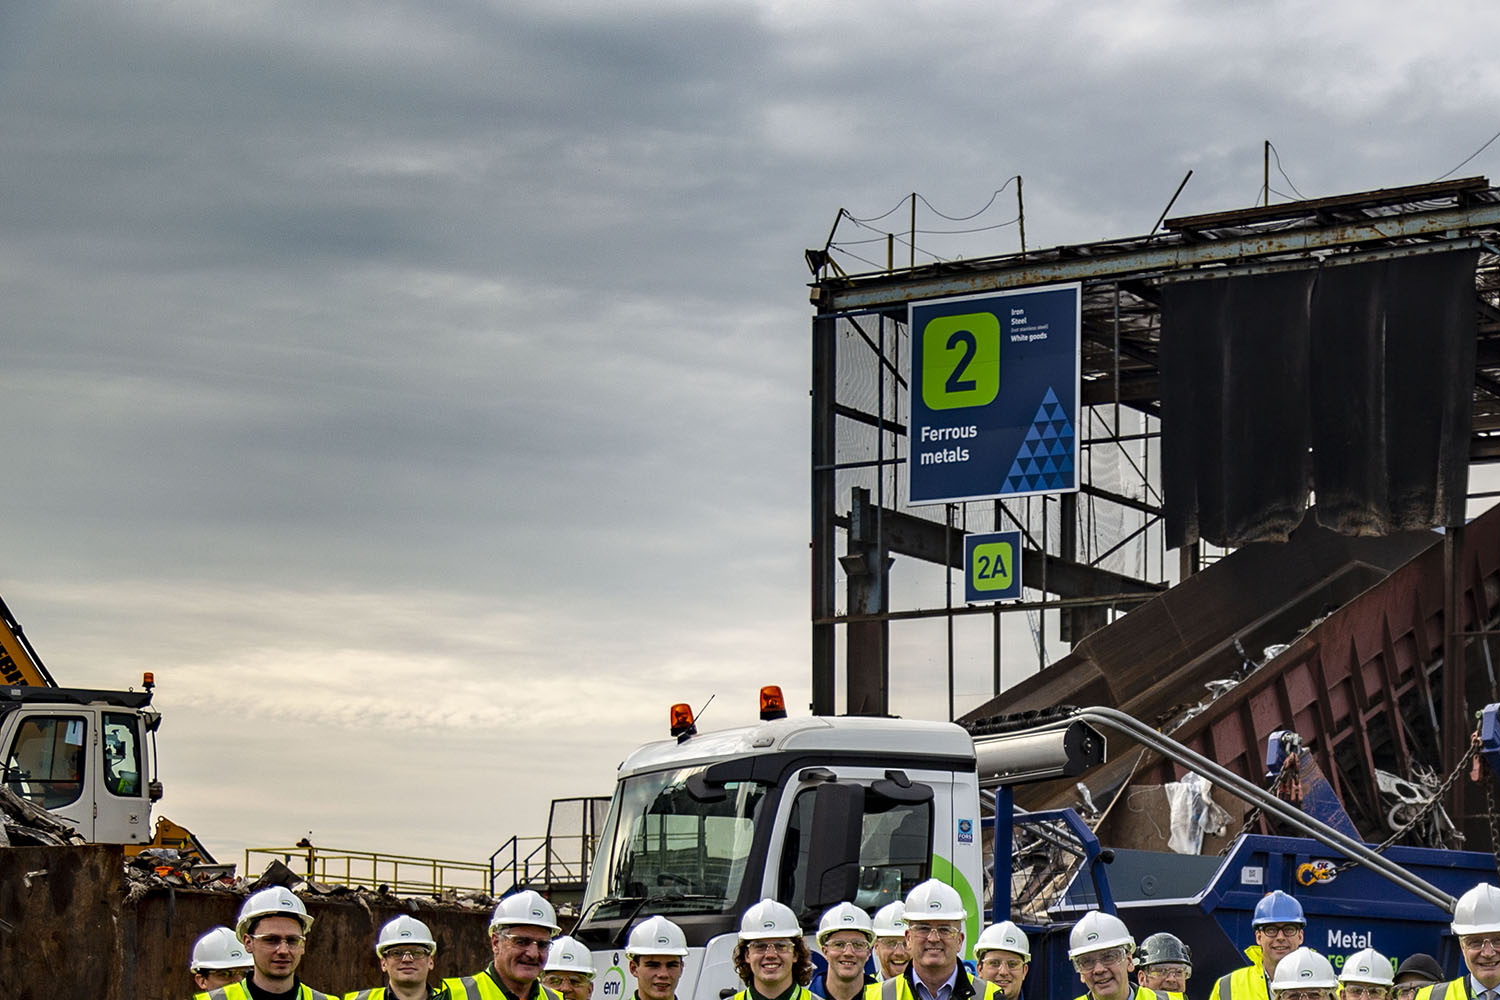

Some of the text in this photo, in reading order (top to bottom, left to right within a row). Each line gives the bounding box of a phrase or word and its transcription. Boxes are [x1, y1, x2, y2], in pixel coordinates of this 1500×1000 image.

[1011, 316, 1027, 325] Steel
[1011, 332, 1047, 342] White goods
[945, 330, 977, 393] 2
[921, 425, 977, 442] Ferrous
[921, 446, 969, 465] metals
[977, 554, 1008, 579] 2A
[1328, 929, 1373, 948] Metal
[604, 981, 621, 994] emr
